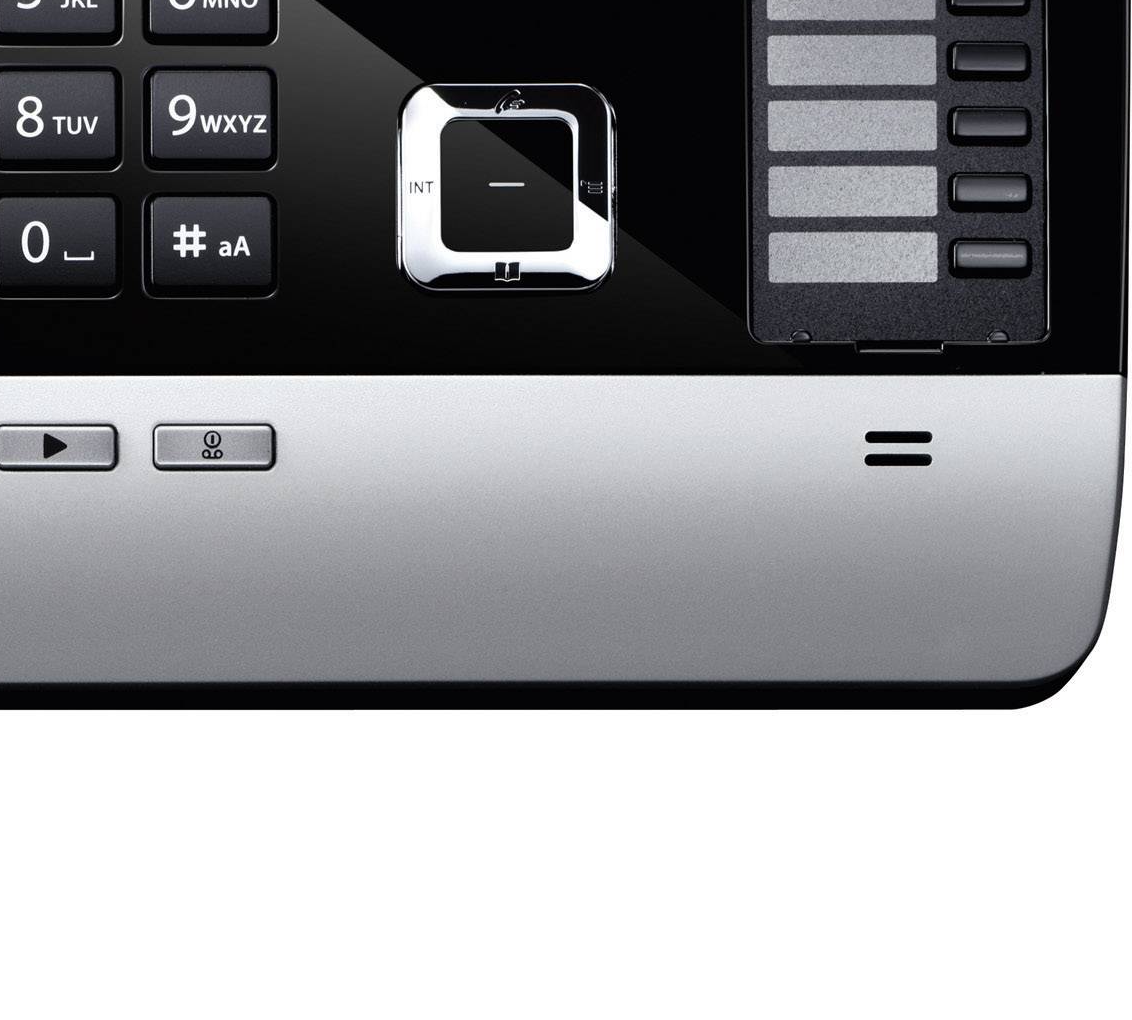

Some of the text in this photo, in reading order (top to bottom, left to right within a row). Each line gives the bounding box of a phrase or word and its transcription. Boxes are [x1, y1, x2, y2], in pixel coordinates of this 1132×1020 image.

[16, 95, 99, 138] 8 TUV
[168, 94, 267, 136] 9 WXYZ
[409, 180, 434, 194] INT
[21, 220, 50, 264] 0
